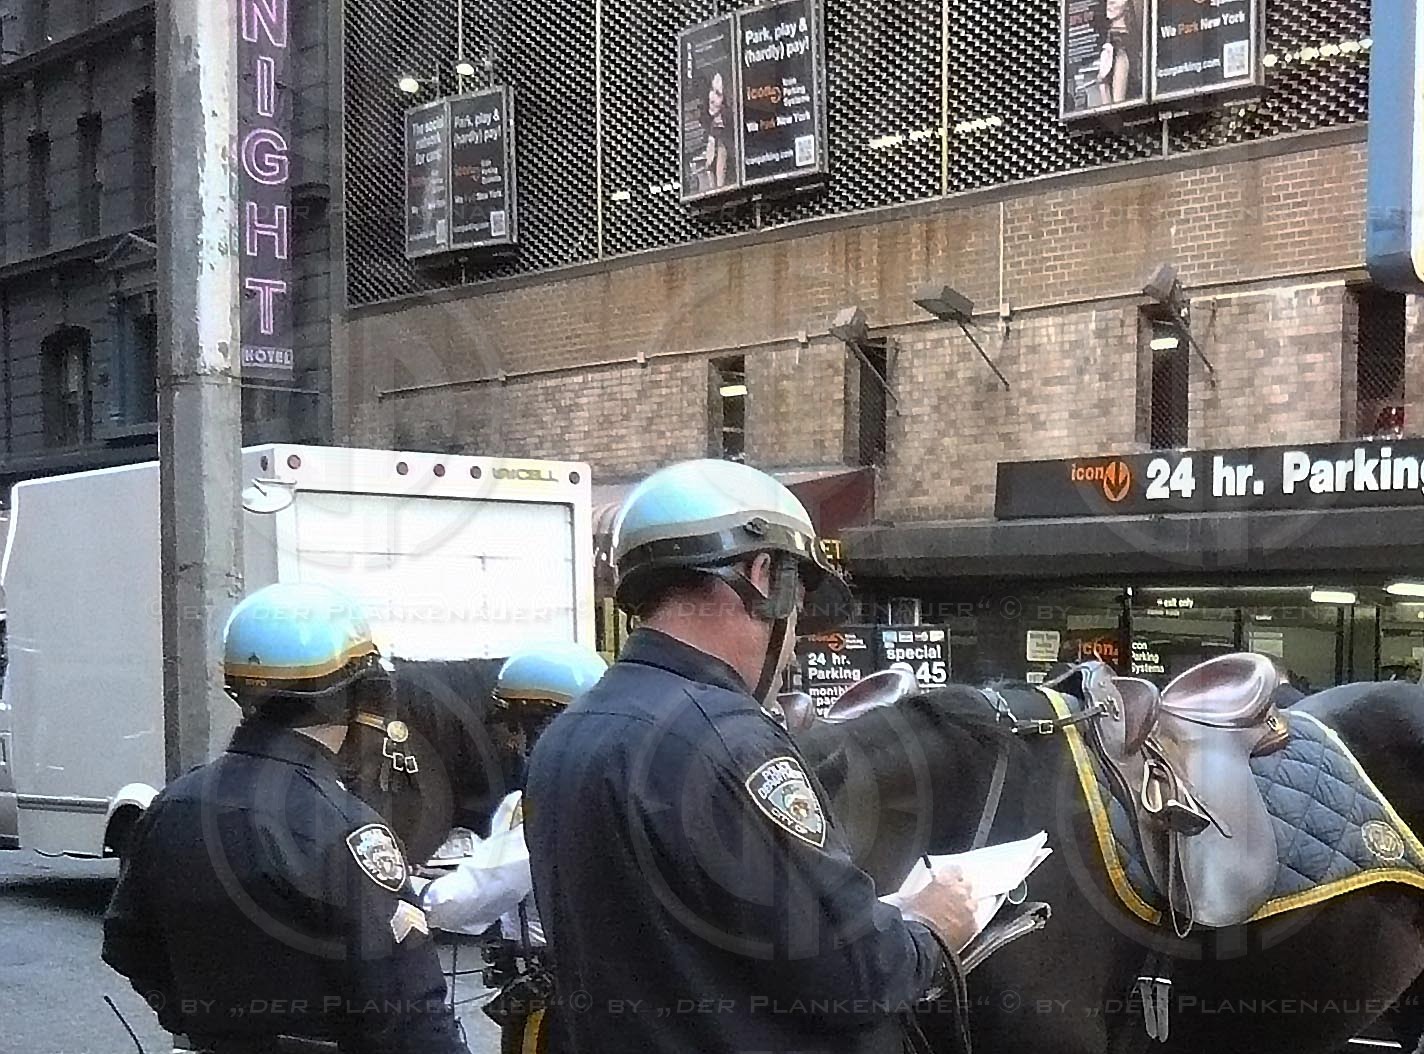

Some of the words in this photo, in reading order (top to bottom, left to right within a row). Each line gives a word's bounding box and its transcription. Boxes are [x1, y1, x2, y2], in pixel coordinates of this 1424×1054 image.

[775, 22, 796, 39] play
[799, 17, 808, 33] &
[1160, 25, 1177, 39] We
[1200, 17, 1221, 31] New
[1222, 10, 1245, 26] York
[242, 0, 287, 335] NIGHT
[246, 351, 292, 364] HOTEL
[1071, 463, 1102, 482] icon
[1146, 457, 1195, 499] 24
[1212, 455, 1264, 497] hr.
[808, 653, 826, 666] 24
[832, 652, 851, 666] hr.
[886, 644, 942, 662] special
[808, 667, 861, 681] Parking
